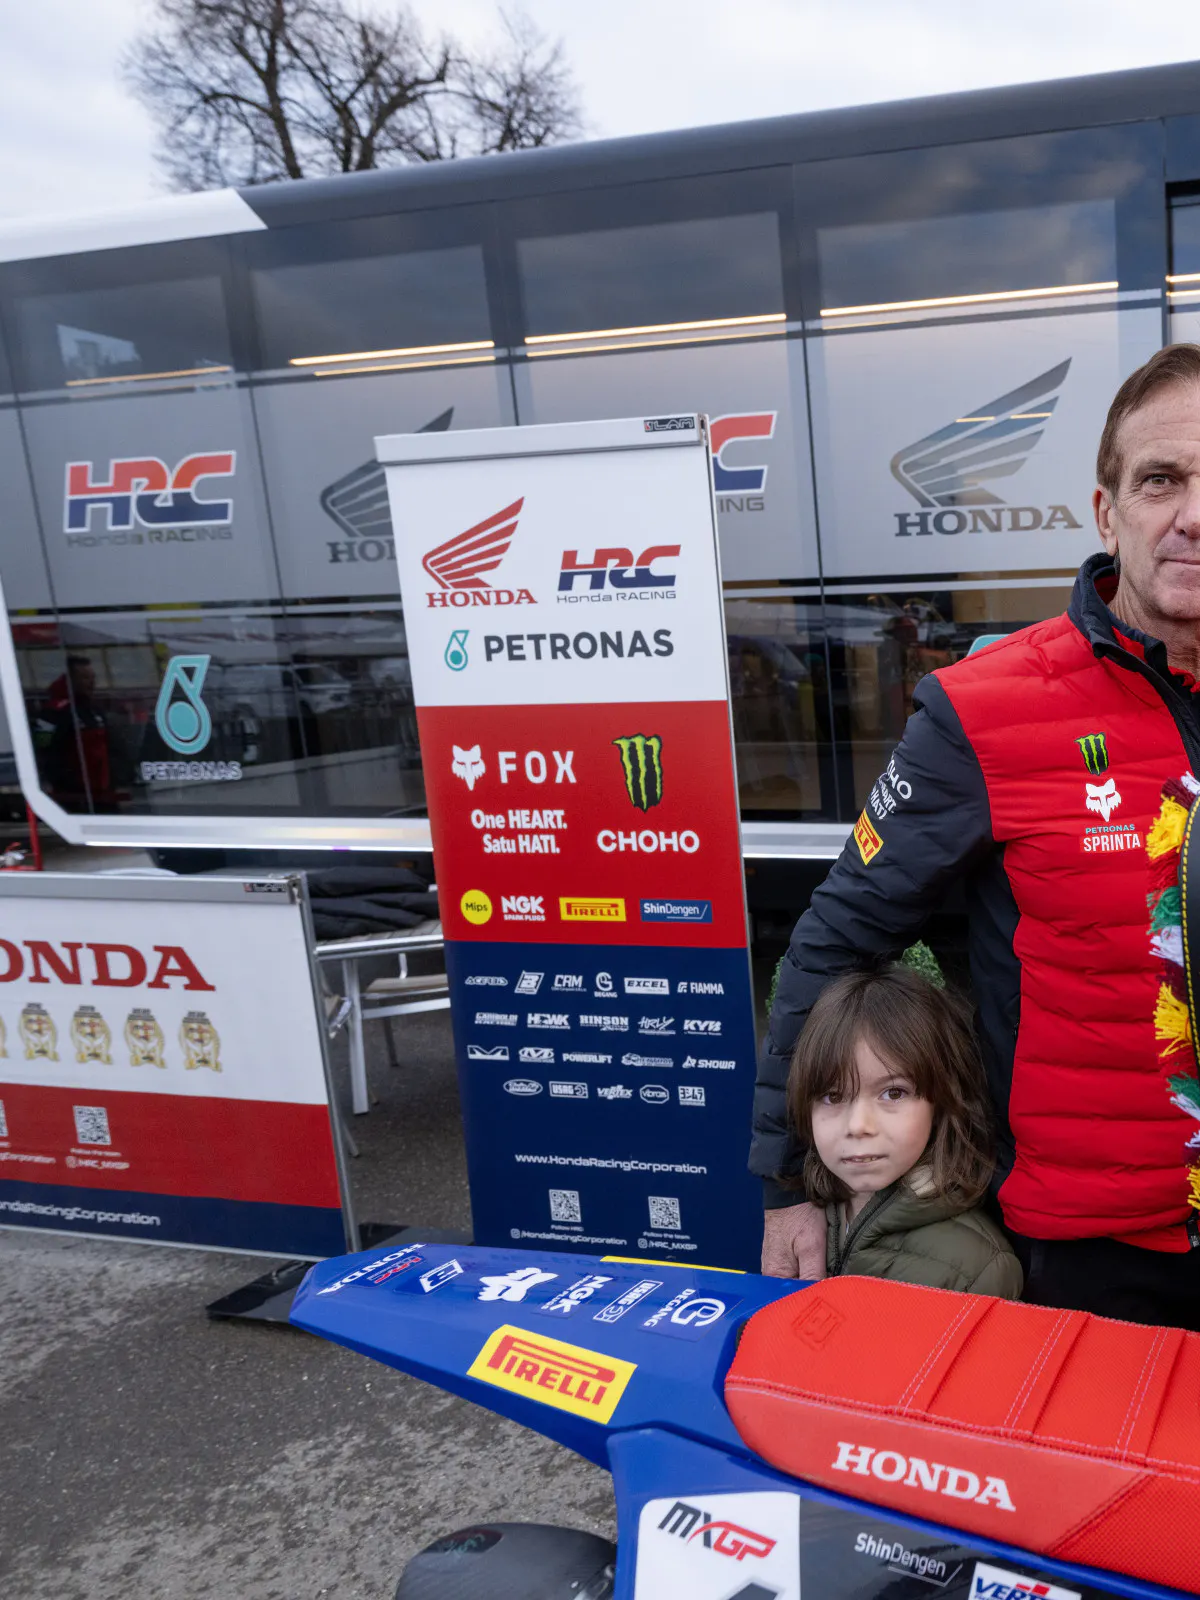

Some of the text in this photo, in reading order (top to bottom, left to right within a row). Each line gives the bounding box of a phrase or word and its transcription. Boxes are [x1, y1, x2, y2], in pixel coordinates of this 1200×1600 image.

[63, 450, 236, 533] HRC
[894, 505, 1083, 537] HONDA
[67, 526, 233, 549] Honda RACING
[557, 544, 681, 592] HRC
[426, 588, 538, 608] HONDA
[556, 591, 677, 604] Honda RACING
[483, 629, 675, 662] PETRONAS
[140, 761, 243, 782] PETRONAS
[498, 750, 577, 784] FOX
[471, 809, 567, 829] One HEART.
[1085, 824, 1135, 834] PETRONAS
[483, 834, 560, 854] Satu HATI.
[597, 829, 700, 853] CHOHO
[1083, 833, 1141, 852] SPRINTA
[465, 902, 488, 913] Mips
[501, 896, 545, 914] NGK
[566, 902, 620, 916] PIRELLI
[643, 903, 700, 916] ShinDengen
[627, 979, 667, 988] EXCEL
[690, 982, 725, 995] FIAMMA
[579, 1015, 629, 1025] HINSON
[683, 1019, 722, 1032] KYB
[562, 1053, 612, 1064] POWERLIFT
[698, 1059, 736, 1070] SHOWA
[597, 1085, 633, 1099] VERTEX
[515, 1154, 707, 1174] www.HondaRacingCorporation
[316, 1243, 427, 1296] HONDA
[550, 1275, 613, 1313] NGK
[644, 1288, 696, 1328] DEGANG
[487, 1334, 616, 1406] PIRELLI
[831, 1441, 1017, 1511] HONDA
[658, 1502, 777, 1561] MXGP
[855, 1533, 946, 1576] ShinDengen
